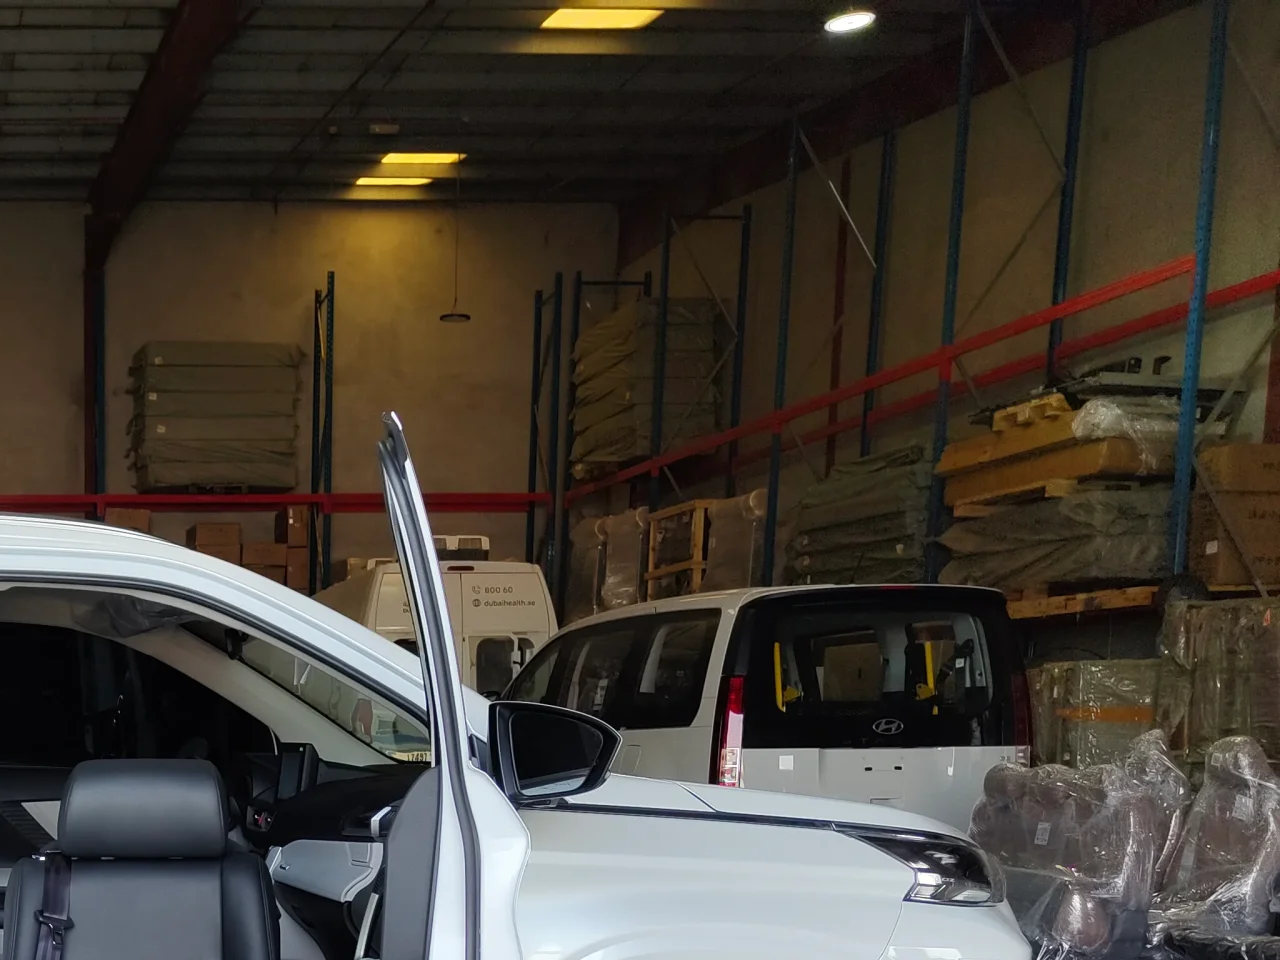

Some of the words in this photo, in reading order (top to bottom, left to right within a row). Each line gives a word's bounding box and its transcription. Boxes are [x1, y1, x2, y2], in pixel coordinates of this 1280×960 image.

[484, 586, 501, 594] 800
[502, 586, 514, 594] 60
[483, 599, 536, 607] dubaihealth.ae
